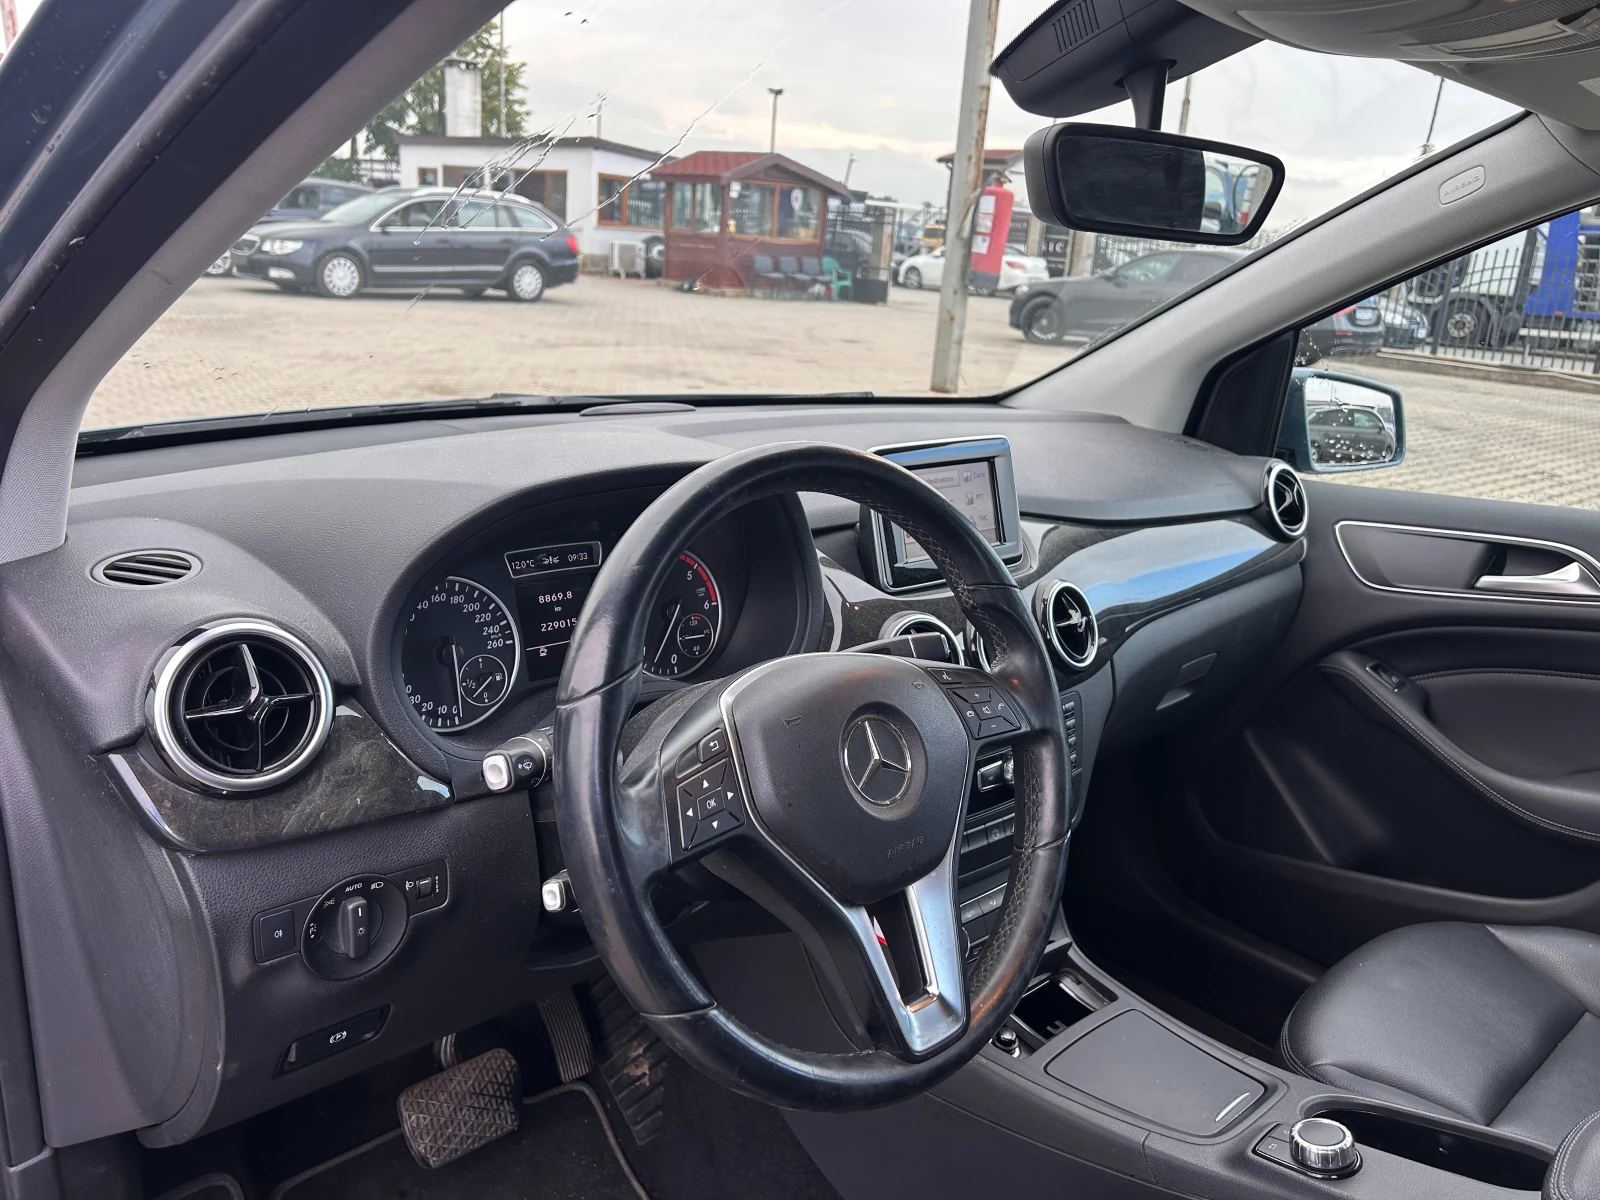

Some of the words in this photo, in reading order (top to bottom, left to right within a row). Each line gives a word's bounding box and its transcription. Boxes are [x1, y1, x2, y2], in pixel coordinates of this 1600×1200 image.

[1443, 174, 1480, 197] AIRBAG
[567, 552, 588, 562] 09:33
[686, 570, 693, 580] 5
[430, 592, 447, 603] 160
[449, 594, 465, 605] 180
[538, 590, 573, 604] 8869.8
[462, 602, 480, 613] 200
[703, 600, 710, 610] 6
[474, 612, 491, 623] 220
[482, 624, 500, 636] 240
[540, 617, 577, 632] 229015
[486, 638, 504, 649] 260
[670, 653, 677, 664] 0
[421, 701, 434, 712] 20
[437, 705, 447, 715] 10
[706, 798, 717, 809] OK
[887, 835, 924, 859] AIRBAG
[344, 882, 363, 893] AUTO
